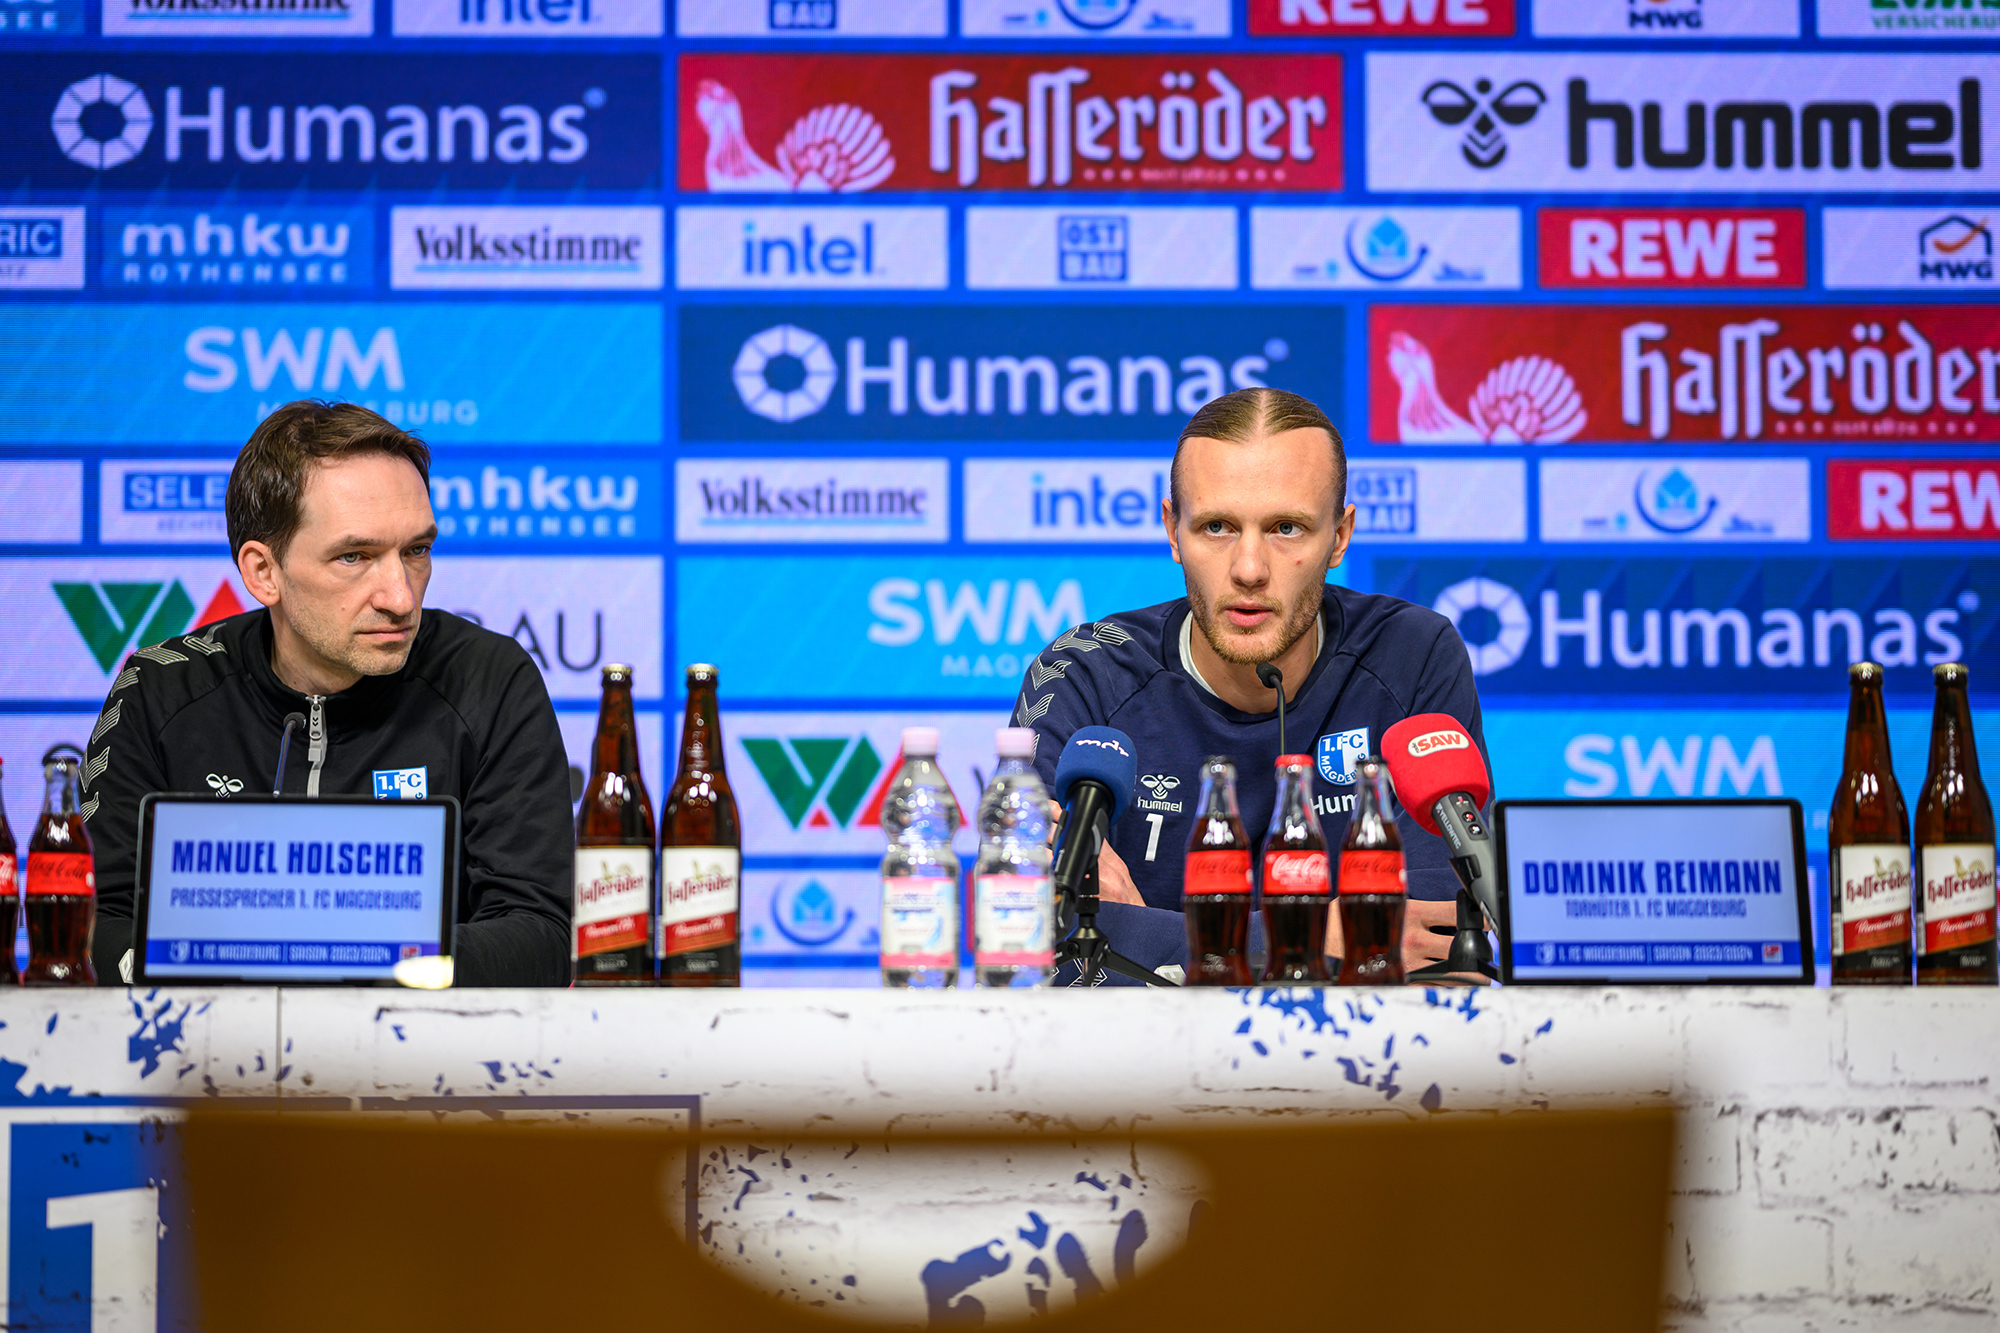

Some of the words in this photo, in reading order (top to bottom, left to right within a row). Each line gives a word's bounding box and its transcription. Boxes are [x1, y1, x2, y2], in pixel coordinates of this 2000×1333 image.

[1629, 11, 1702, 28] MWG
[165, 86, 588, 163] Humanas
[1568, 78, 1981, 169] hummel
[123, 213, 349, 257] mhkw
[415, 225, 642, 261] Volksstimme
[743, 221, 874, 275] intel
[1067, 224, 1118, 246] OST
[1570, 219, 1779, 278] REWE
[123, 263, 348, 284] ROTHENSEE
[1063, 253, 1124, 278] BAU
[1920, 260, 1994, 281] MWG
[185, 326, 405, 392] SWM
[699, 479, 926, 515] Volksstimme
[1032, 472, 1163, 526] intel
[1356, 477, 1405, 497] OST
[437, 516, 636, 538] OTHENSEE
[867, 578, 1086, 646] SWM
[1540, 590, 1963, 668] Humanas
[455, 612, 602, 671] AU
[1076, 739, 1129, 757] mdr
[1417, 734, 1460, 751] SAW
[1564, 734, 1783, 798] SWM
[1137, 796, 1182, 813] hummel
[1310, 794, 1358, 816] Hum
[1144, 812, 1164, 861] 1
[1439, 811, 1461, 849] YELLOWTEC
[171, 840, 278, 874] MANUEL
[1523, 861, 1647, 894] DOMINIK
[1655, 861, 1782, 894] REIMANN
